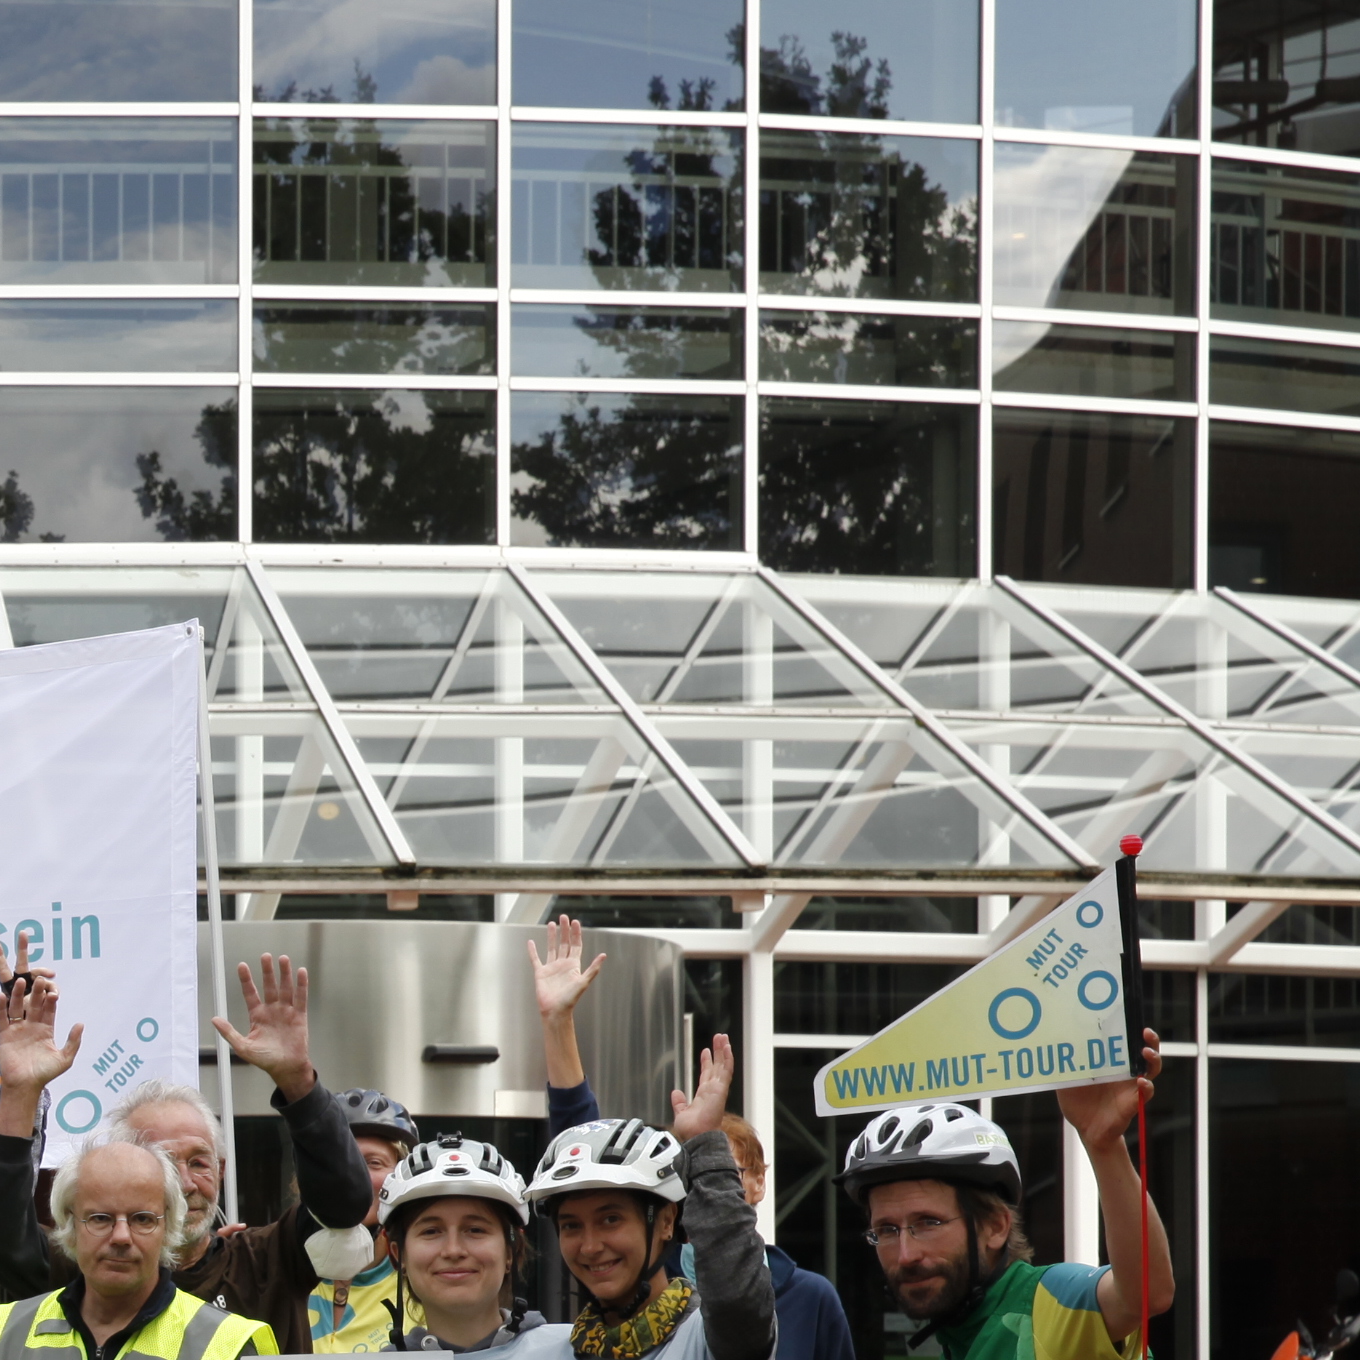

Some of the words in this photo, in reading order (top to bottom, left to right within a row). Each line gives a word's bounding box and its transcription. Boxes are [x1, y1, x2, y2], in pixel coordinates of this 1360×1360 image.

[1025, 927, 1065, 971] MUT
[1042, 942, 1089, 989] TOUR
[92, 1038, 126, 1077] MUT
[104, 1053, 145, 1095] TOUR
[832, 1035, 1126, 1101] WWW.MUT-TOUR.DE
